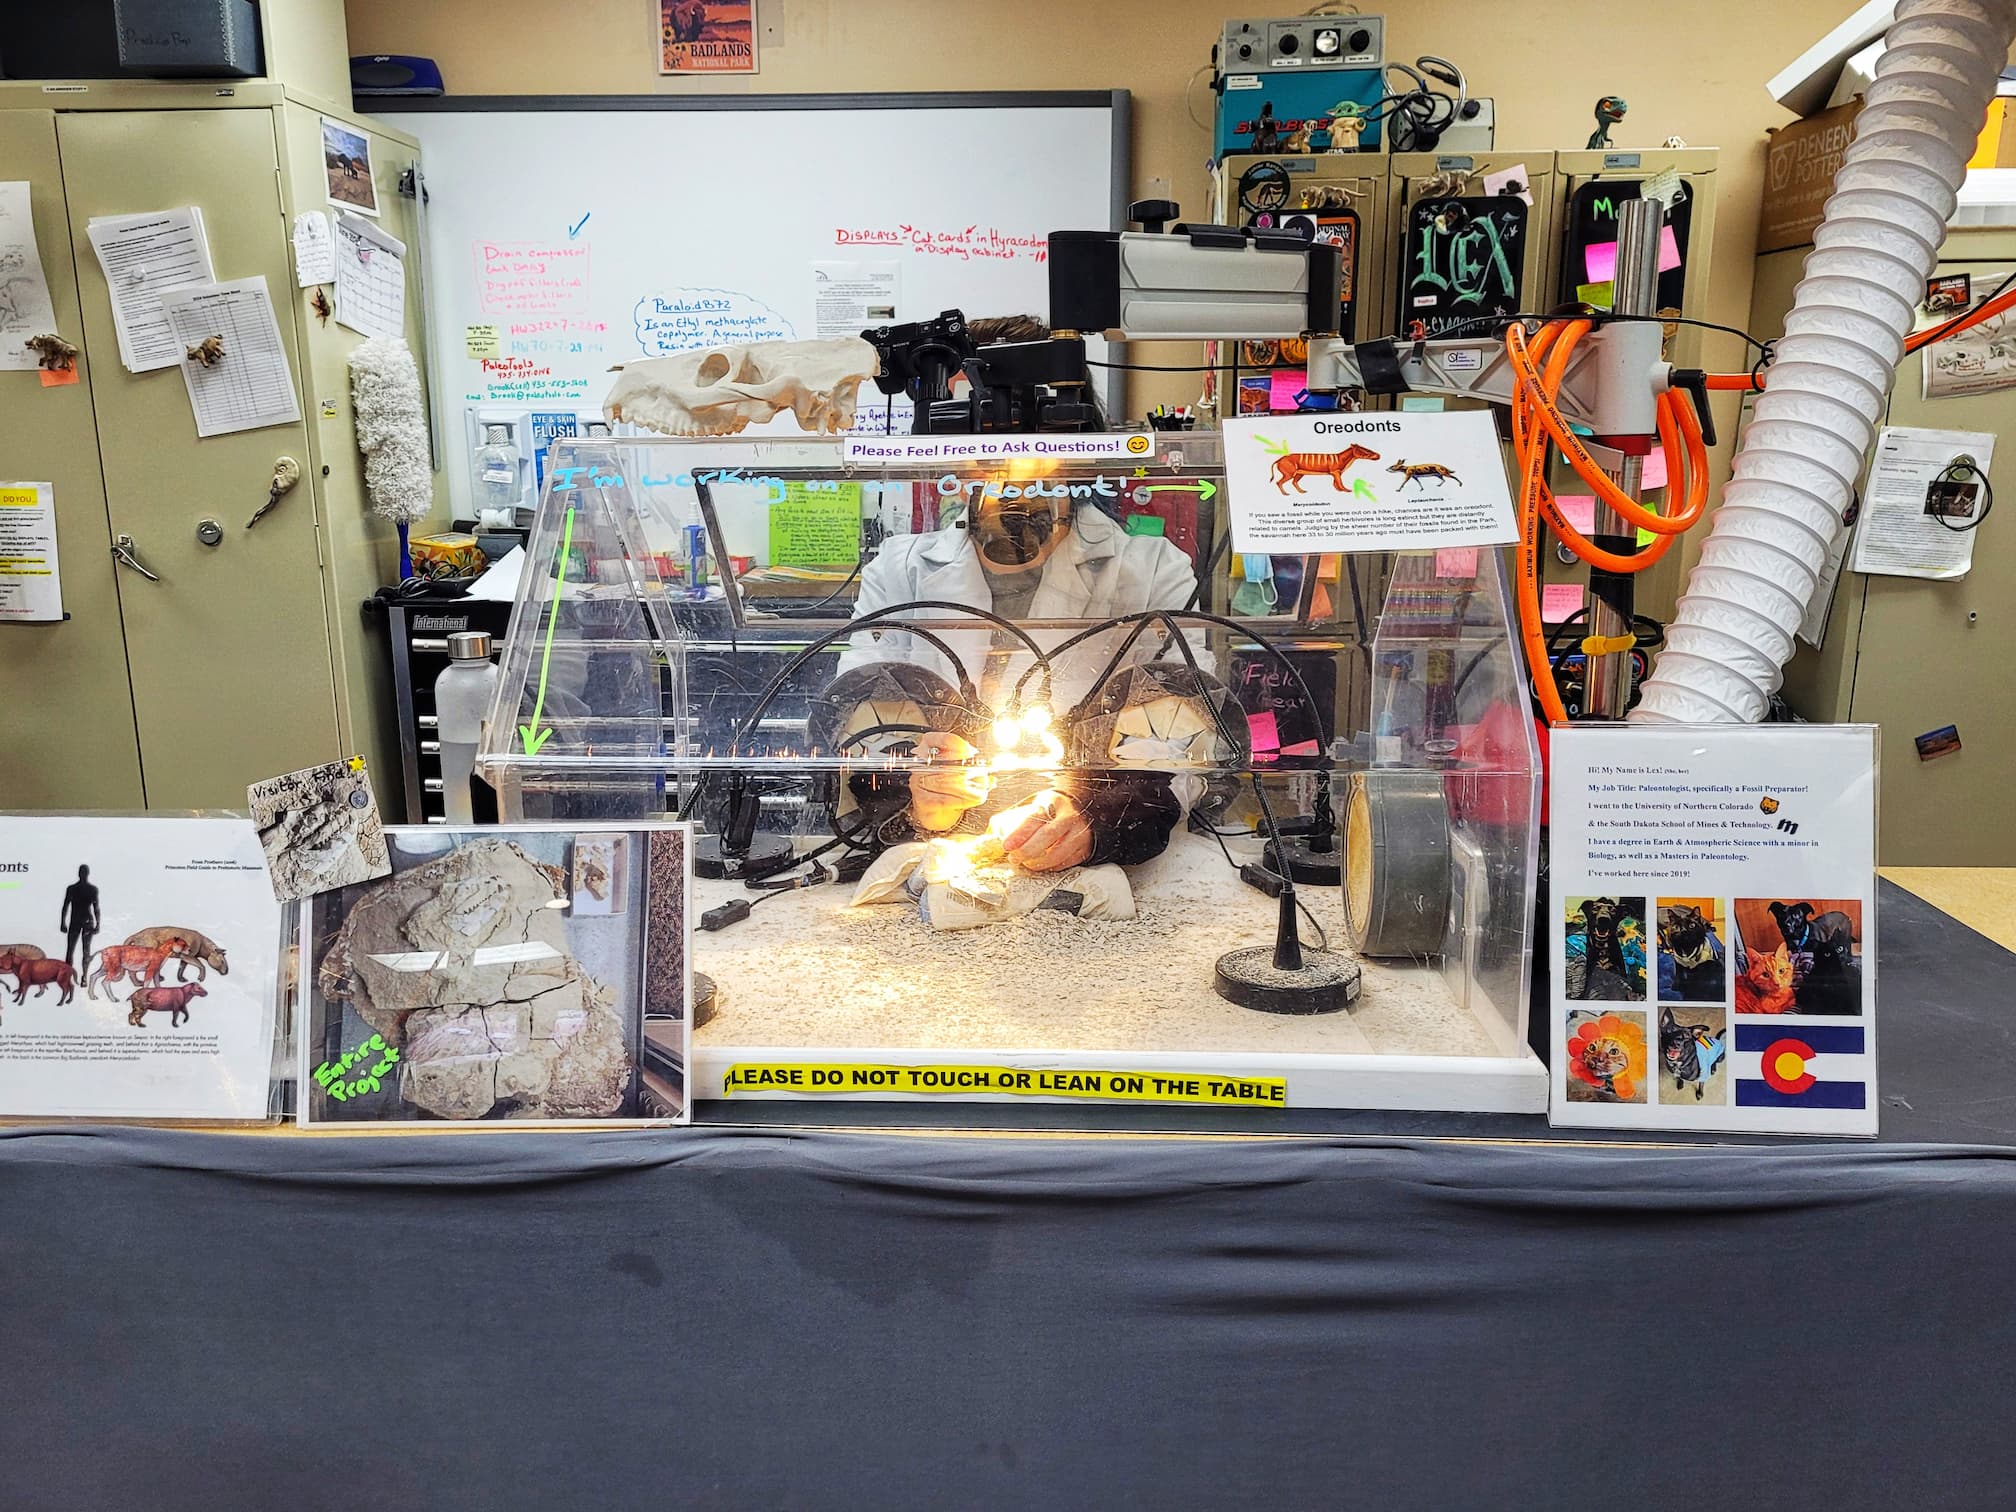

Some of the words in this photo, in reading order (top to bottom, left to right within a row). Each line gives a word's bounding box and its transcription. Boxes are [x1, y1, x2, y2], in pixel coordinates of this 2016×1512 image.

[691, 44, 751, 57] BADLANDS
[533, 415, 545, 423] EYE
[535, 425, 575, 438] FLUSH
[1314, 420, 1401, 434] Oreodonts
[852, 444, 901, 456] Please
[907, 445, 938, 456] Feel
[943, 443, 976, 455] Free
[981, 443, 997, 454] to
[1002, 441, 1030, 453] Ask
[1034, 440, 1119, 453] Questions!
[552, 466, 623, 491] I'm
[937, 474, 1131, 498] Oreodont!
[413, 615, 469, 630] International
[1588, 766, 1599, 774] Hi!
[1602, 766, 1612, 775] My
[1616, 766, 1635, 774] Name
[1646, 766, 1662, 774] Lex!
[1588, 784, 1599, 792] My
[1638, 784, 1691, 793] Paleontologist,
[1693, 785, 1732, 794] specifically
[1742, 784, 1762, 792] Fossil
[1765, 785, 1807, 794] Preparator!
[1635, 802, 1670, 811] University
[1683, 802, 1717, 810] Northern
[1719, 802, 1753, 810] Colorado
[1588, 819, 1594, 827] &
[1610, 819, 1630, 827] South
[1661, 820, 1684, 828] School
[1687, 820, 1694, 828] of
[1696, 820, 1718, 828] Mines
[1731, 821, 1773, 830] Technology.
[1618, 838, 1641, 847] degree
[1686, 839, 1730, 847] Atmospheric
[1588, 851, 1617, 860] Biology,
[1691, 852, 1698, 860] in
[1701, 852, 1749, 861] Paleontology.
[1604, 869, 1630, 877] worked
[1633, 869, 1648, 877] here
[314, 1034, 386, 1087] Entire
[327, 1047, 400, 1102] Project
[724, 1070, 803, 1092] PLEASE
[812, 1070, 844, 1085] DO
[852, 1071, 899, 1086] NOT
[908, 1071, 990, 1087] TOUCH
[998, 1073, 1031, 1089] OR
[1040, 1074, 1100, 1092] LEAN
[1110, 1077, 1143, 1093] ON
[1152, 1079, 1199, 1096] THE
[1208, 1082, 1284, 1101] TABLE
